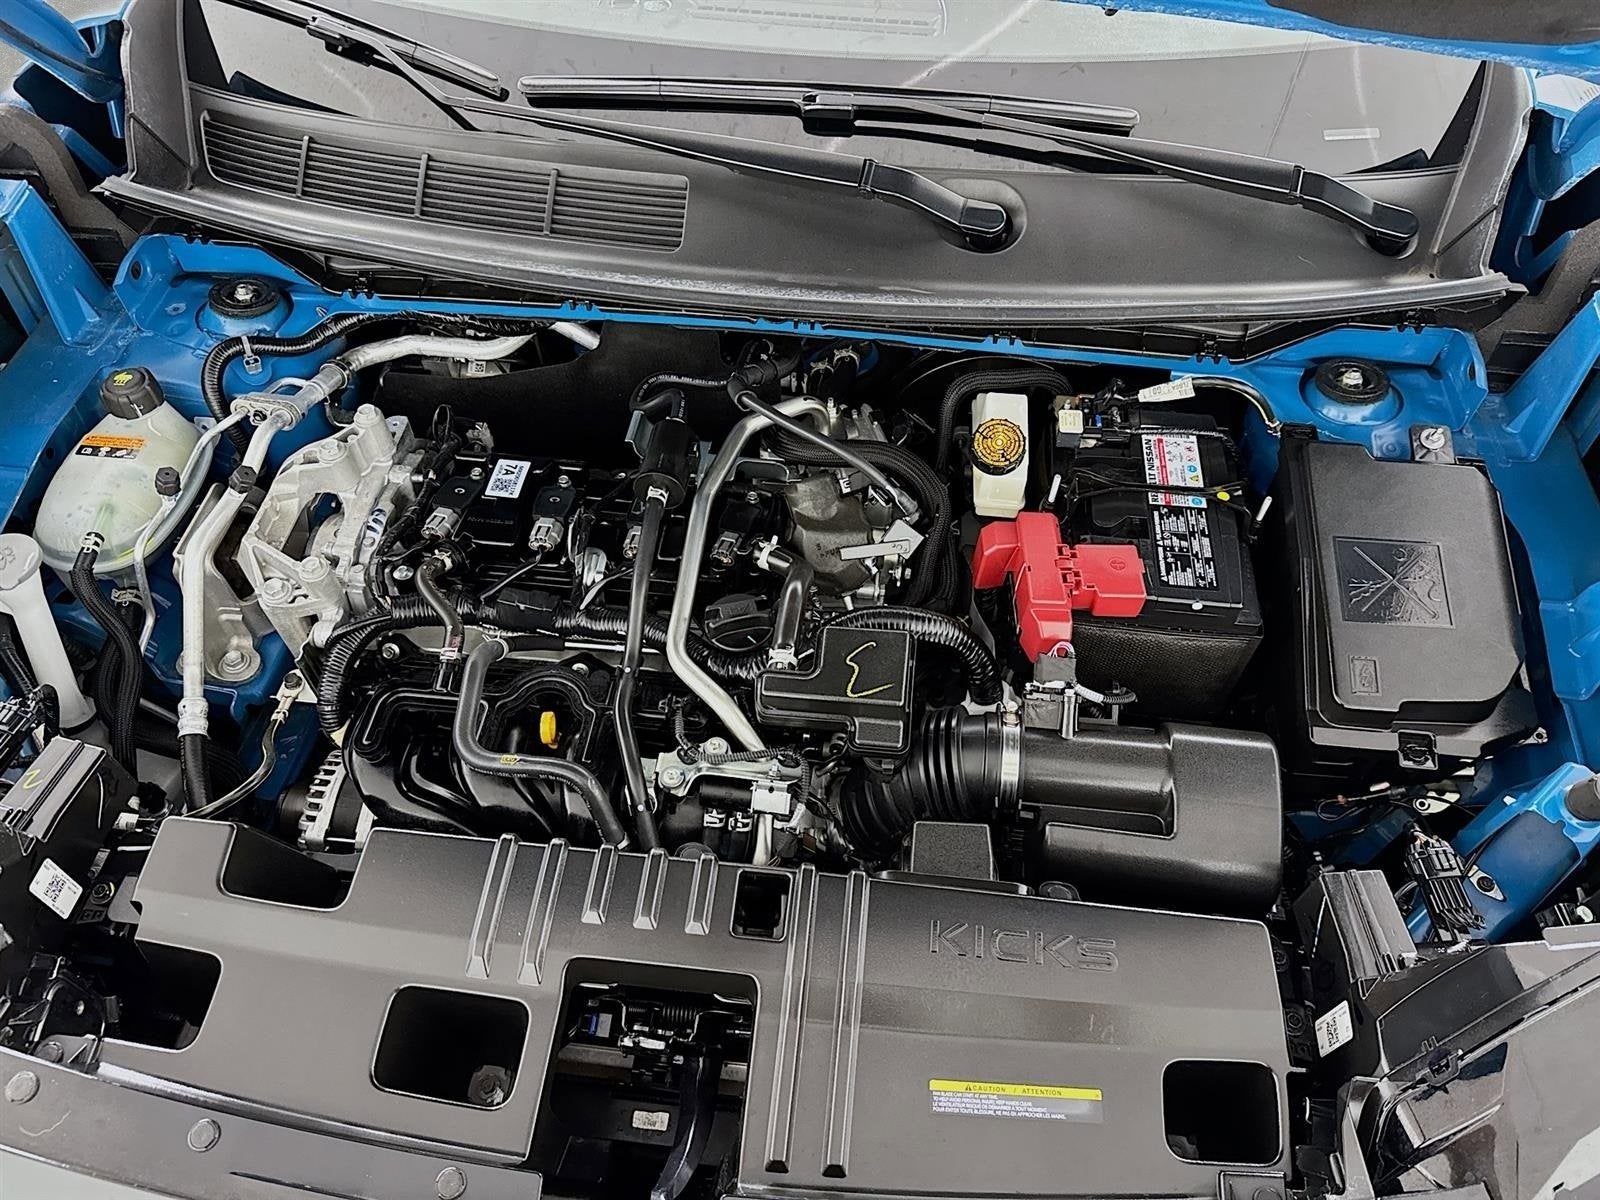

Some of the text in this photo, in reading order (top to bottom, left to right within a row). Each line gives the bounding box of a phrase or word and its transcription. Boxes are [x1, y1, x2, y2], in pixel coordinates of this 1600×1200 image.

[1144, 438, 1155, 471] NISSAN
[502, 464, 518, 476] 7A
[929, 919, 1119, 973] KICKS
[972, 1084, 1006, 1092] CAUTION
[1022, 1088, 1062, 1096] ATTENTION
